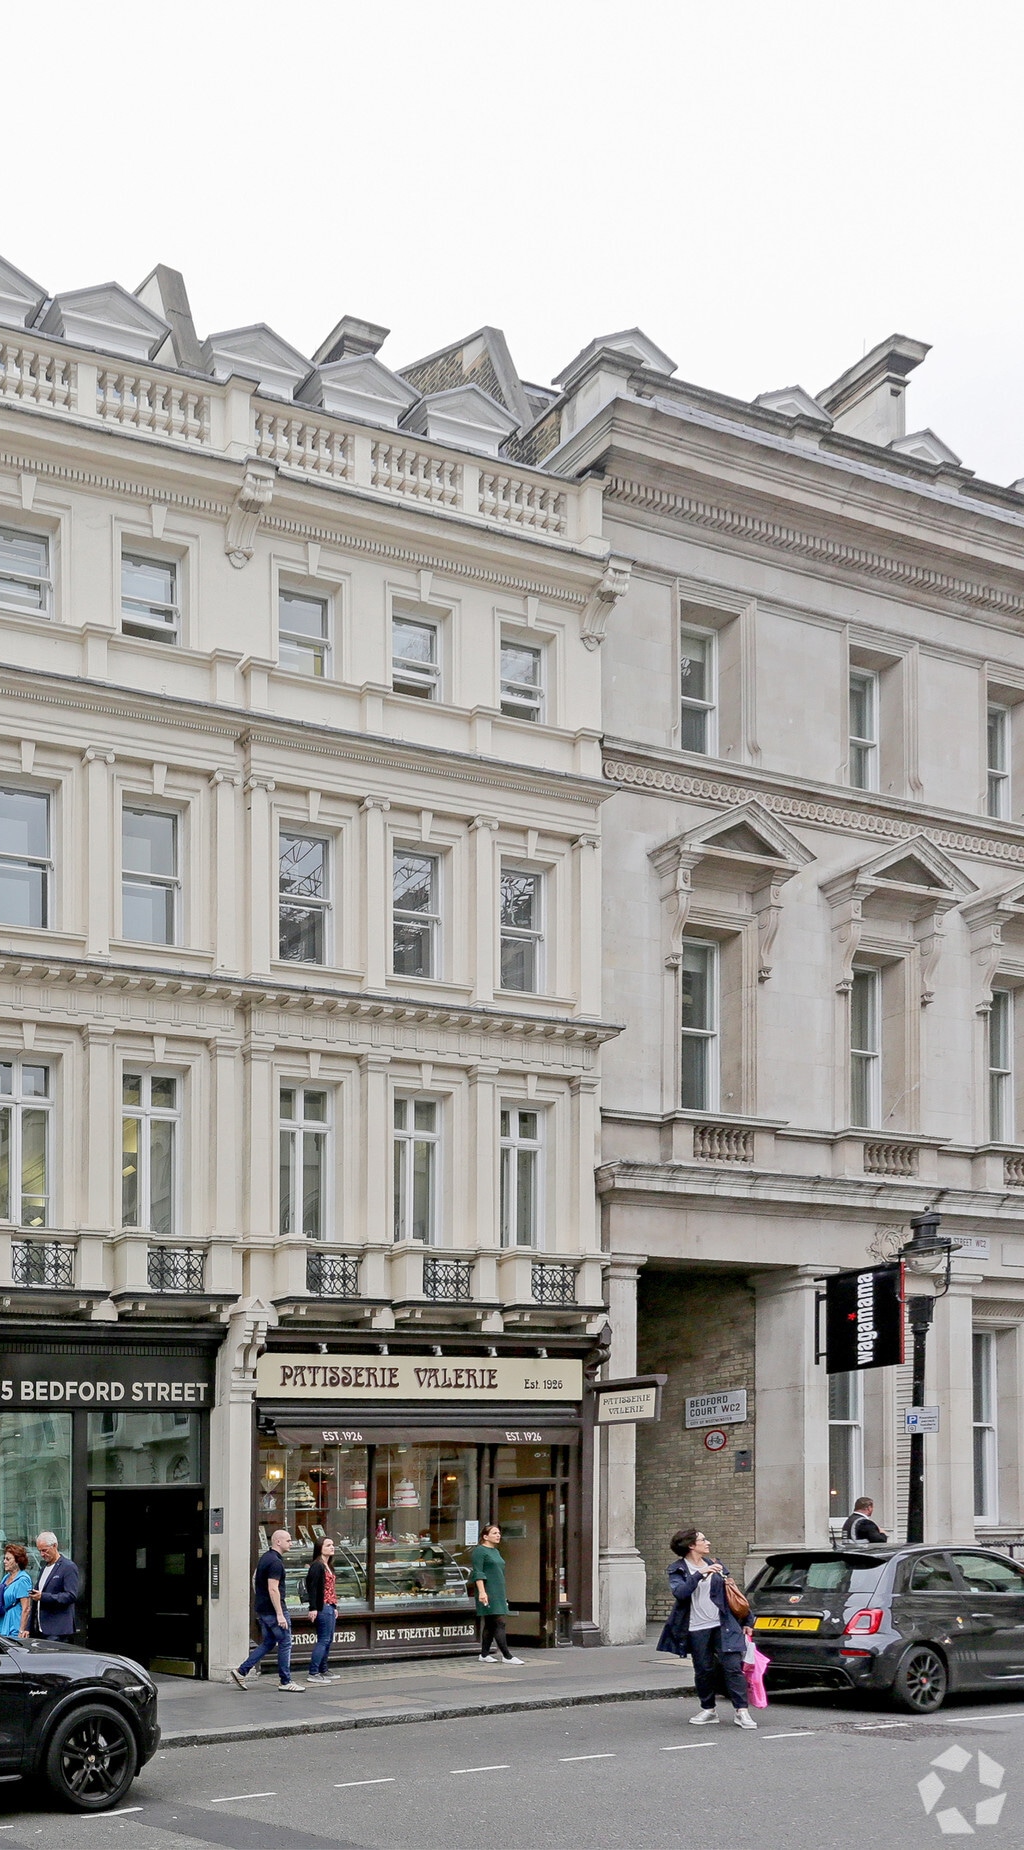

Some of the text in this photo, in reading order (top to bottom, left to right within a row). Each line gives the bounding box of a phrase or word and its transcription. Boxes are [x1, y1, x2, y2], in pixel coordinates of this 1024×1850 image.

[857, 1272, 878, 1365] wagamama
[280, 1365, 499, 1390] PATISSERIE VALERIE
[21, 1381, 125, 1401] BEDFORD
[131, 1382, 209, 1401] STREET
[524, 1378, 564, 1391] Est. 1926
[603, 1394, 651, 1406] PATISSERIE
[690, 1395, 728, 1408] BEDFORD
[608, 1405, 645, 1415] VALERIE
[690, 1403, 741, 1417] COURT WC2
[343, 1431, 363, 1442] 1926
[506, 1431, 542, 1441] EST. 1926
[781, 1619, 804, 1628] ALY
[333, 1631, 356, 1643] TEAS
[376, 1624, 475, 1641] PRE THEATRE MEALS
